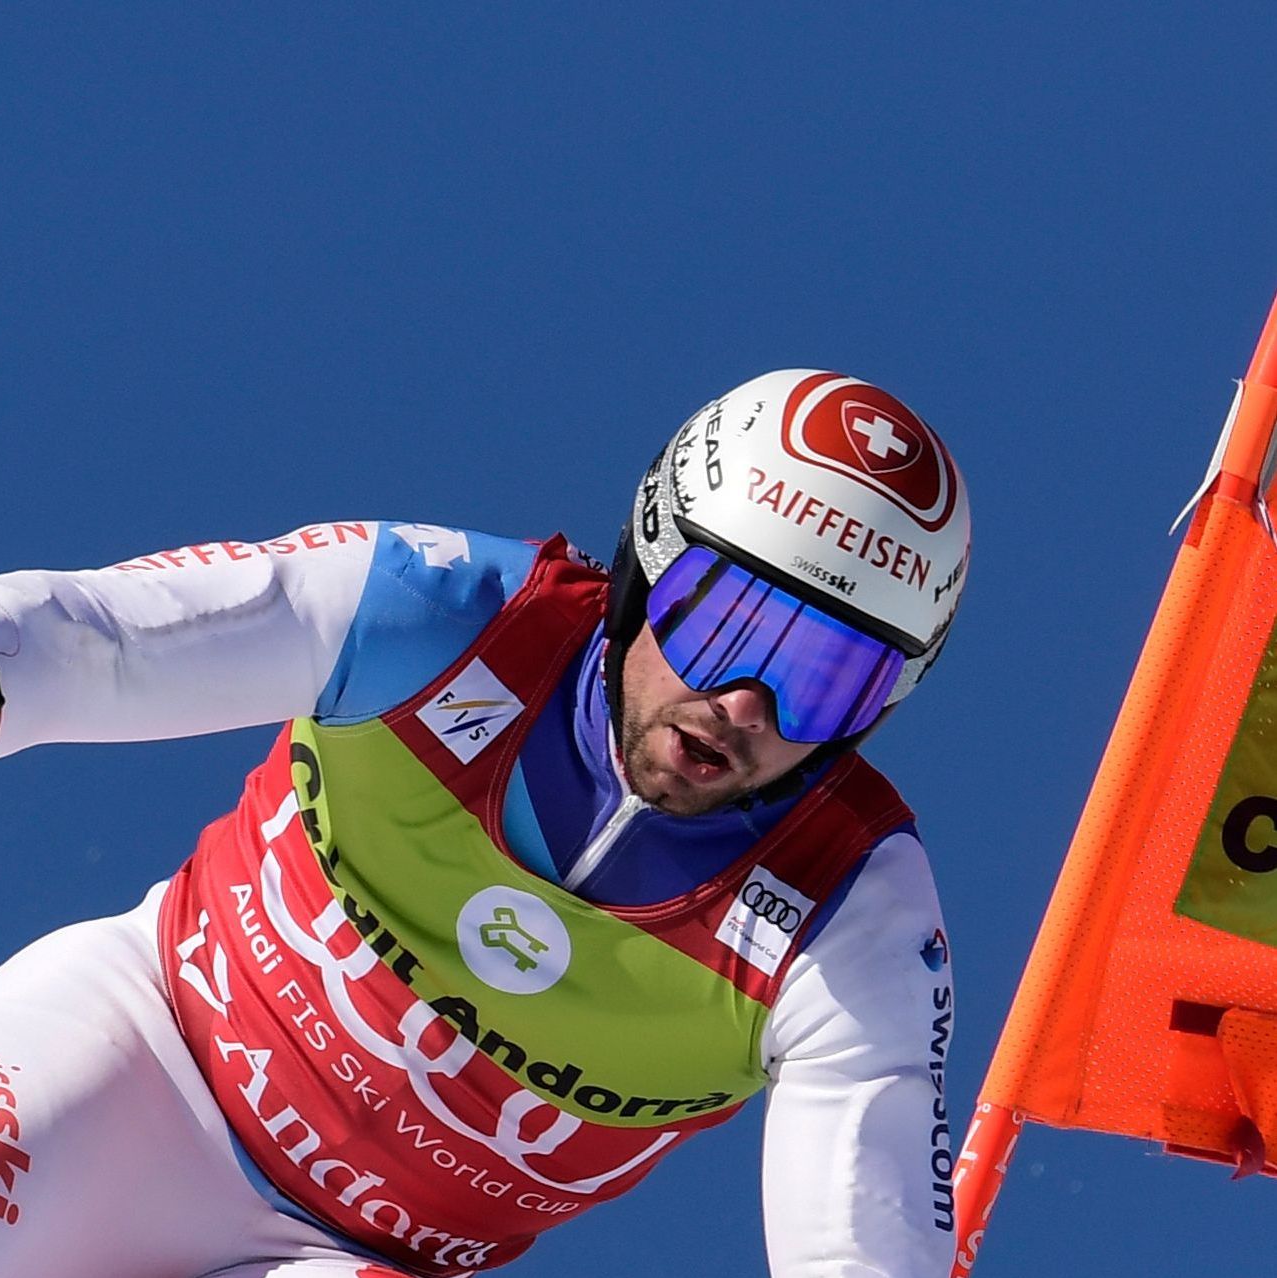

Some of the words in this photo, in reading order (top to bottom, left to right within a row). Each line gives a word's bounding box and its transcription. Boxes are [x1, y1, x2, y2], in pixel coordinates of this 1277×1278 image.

[746, 466, 932, 593] RAIFFEISEN
[436, 691, 489, 742] FIS
[229, 884, 283, 975] Audi
[276, 979, 336, 1051] FIS
[330, 1052, 390, 1112] Ski
[395, 1109, 513, 1199] World
[515, 1192, 580, 1216] Cup
